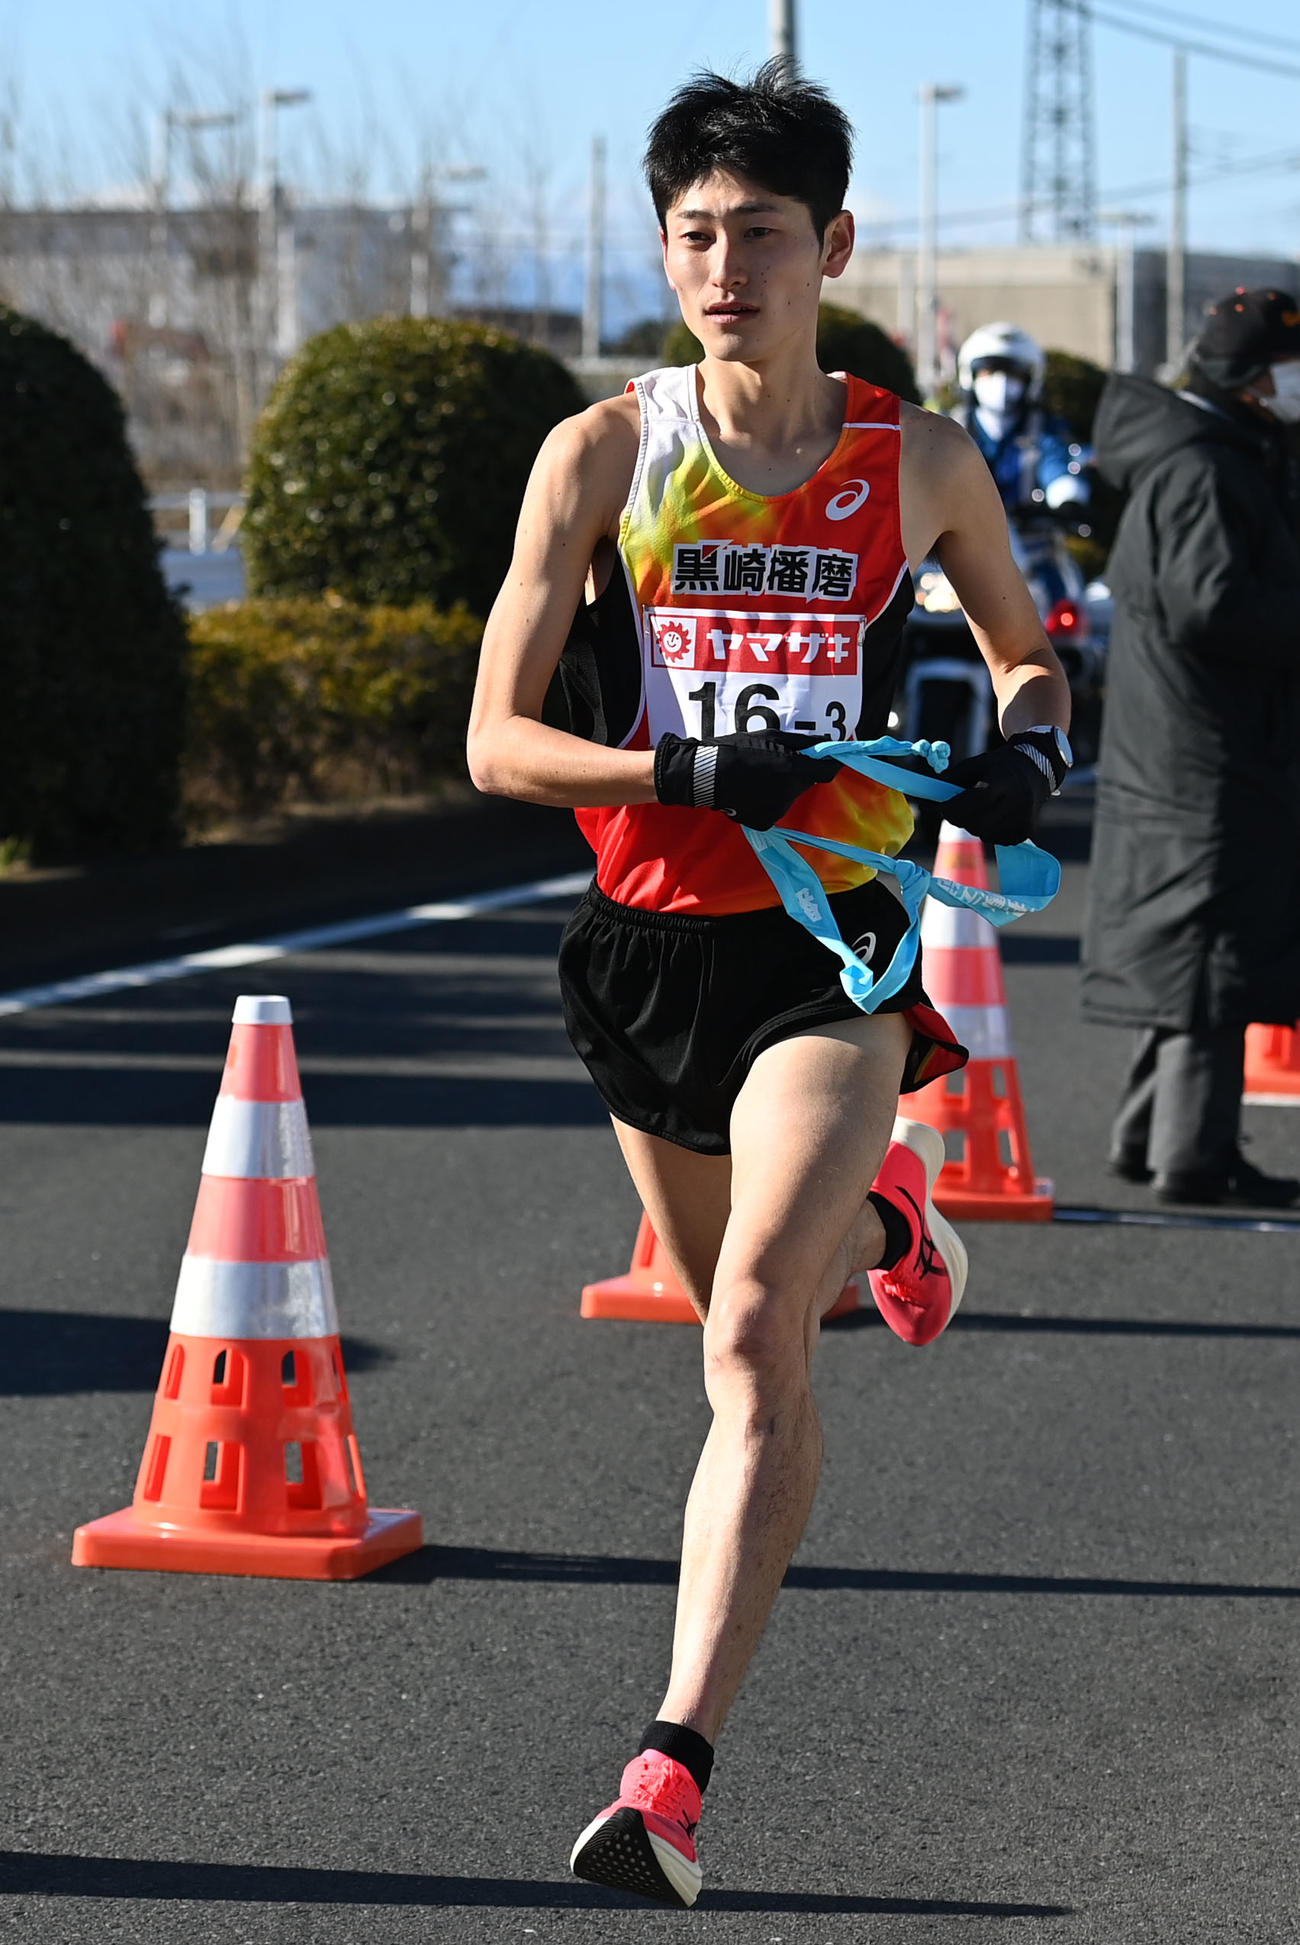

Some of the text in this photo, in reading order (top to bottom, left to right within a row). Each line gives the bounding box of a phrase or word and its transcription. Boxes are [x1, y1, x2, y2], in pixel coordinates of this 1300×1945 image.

[673, 547, 855, 599] 黒崎播磨
[705, 628, 852, 664] ヤマザキ
[688, 681, 847, 742] 16-3
